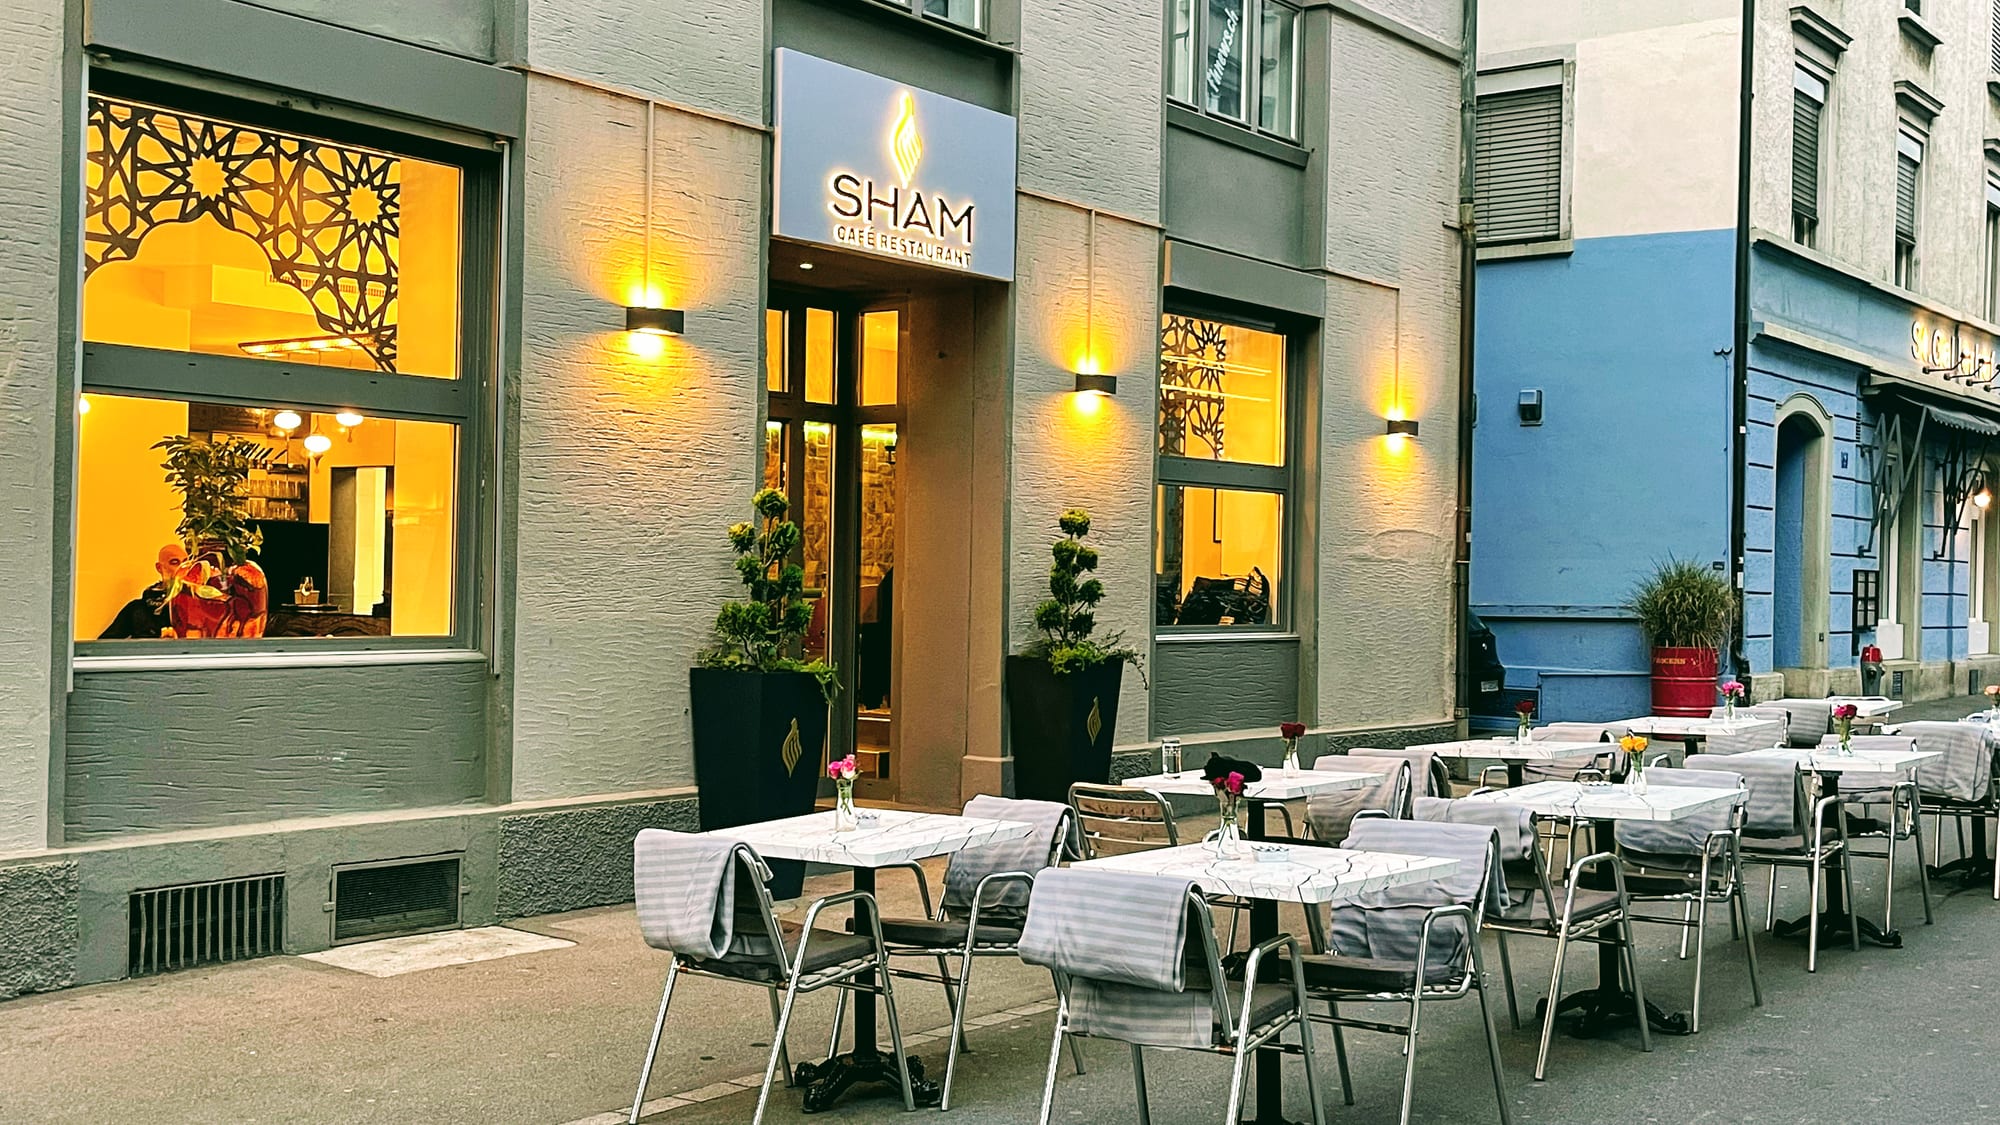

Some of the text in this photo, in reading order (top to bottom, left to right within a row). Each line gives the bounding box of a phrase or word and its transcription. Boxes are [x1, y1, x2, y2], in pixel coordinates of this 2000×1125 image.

[832, 174, 975, 244] SHAM
[836, 226, 972, 267] CAFÉ RESTAURANT
